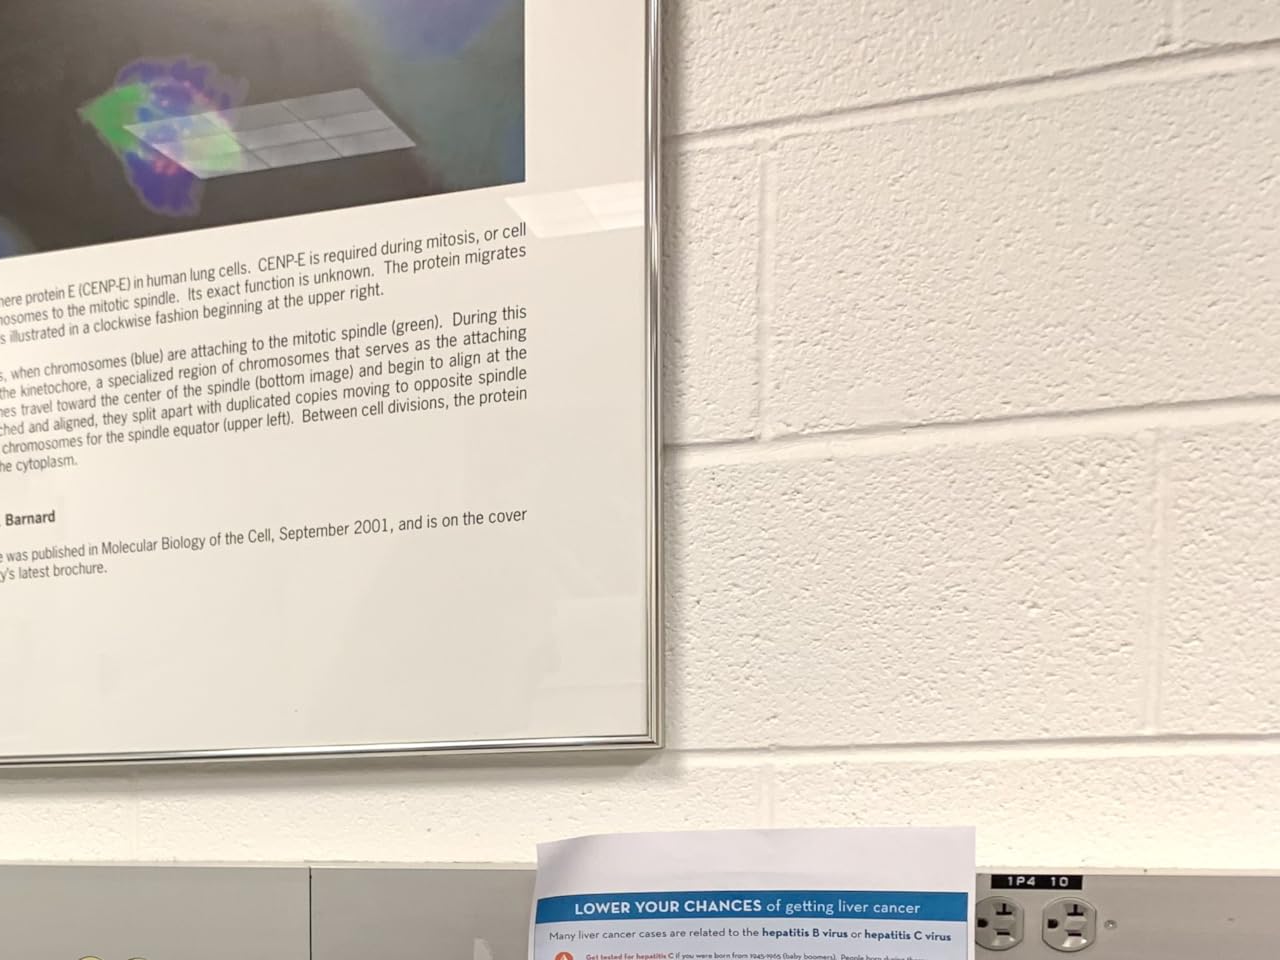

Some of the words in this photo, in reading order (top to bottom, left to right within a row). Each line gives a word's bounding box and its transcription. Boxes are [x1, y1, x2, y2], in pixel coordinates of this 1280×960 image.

[24, 287, 65, 305] protein
[67, 283, 75, 297] E
[78, 276, 130, 297] (CENP-E)
[133, 276, 143, 288] in
[146, 271, 186, 287] human
[189, 267, 215, 281] lung
[218, 260, 250, 277] cells.
[257, 251, 305, 271] CENP-E
[309, 250, 320, 265] is
[323, 241, 377, 263] required
[380, 238, 422, 255] during
[426, 229, 479, 248] mitosis,
[483, 228, 498, 241] or
[502, 221, 526, 238] cell
[133, 290, 179, 309] spindle.
[187, 287, 202, 300] Its
[206, 281, 240, 298] exact
[244, 275, 294, 293] function
[298, 272, 309, 286] is
[313, 266, 374, 284] unknown.
[383, 260, 408, 274] The
[413, 252, 459, 273] protein
[464, 245, 526, 265] migrates
[92, 314, 151, 332] clockwise
[155, 307, 198, 324] fashion
[202, 299, 262, 319] beginning
[267, 295, 279, 310] at
[283, 294, 303, 307] the
[308, 289, 345, 306] upper
[350, 282, 383, 301] right.
[130, 348, 163, 366] (blue)
[167, 349, 186, 361] are
[190, 340, 247, 358] attaching
[251, 337, 264, 351] to
[268, 335, 288, 349] the
[292, 328, 336, 346] mitotic
[341, 322, 386, 341] spindle
[391, 315, 442, 336] (green).
[452, 310, 497, 326] During
[502, 305, 526, 320] this
[178, 362, 216, 379] region
[221, 359, 233, 373] of
[238, 350, 329, 371] chromosomes
[334, 344, 359, 360] that
[365, 341, 409, 357] serves
[414, 339, 430, 351] as
[436, 334, 457, 348] the
[463, 327, 526, 345] attaching
[309, 364, 353, 383] image)
[358, 361, 382, 377] and
[387, 357, 424, 375] begin
[429, 356, 443, 369] to
[448, 352, 480, 368] align
[486, 348, 500, 363] at
[505, 346, 526, 360] the
[226, 391, 290, 412] duplicated
[295, 388, 337, 405] copies
[342, 382, 390, 399] moving
[395, 379, 408, 393] to
[414, 373, 472, 392] opposite
[478, 366, 526, 386] spindle
[302, 406, 357, 423] Between
[361, 401, 383, 416] cell
[387, 397, 448, 413] divisions,
[453, 393, 474, 407] the
[479, 387, 526, 406] protein
[4, 509, 55, 526] Barnard
[5, 550, 28, 561] was
[31, 543, 85, 561] published
[88, 543, 98, 555] in
[101, 538, 157, 554] Molecular
[161, 535, 205, 550] Biology
[209, 531, 221, 545] of
[224, 531, 244, 544] the
[247, 527, 274, 543] Cell,
[279, 522, 349, 541] September
[354, 518, 393, 534] 2001,
[398, 515, 422, 530] and
[426, 515, 437, 528] is
[441, 515, 458, 527] on
[462, 511, 483, 525] the
[488, 510, 527, 523] cover
[18, 565, 50, 579] latest
[52, 561, 107, 576] brochure.
[1007, 876, 1036, 887] 1P4
[574, 901, 630, 915] LOWER
[634, 900, 679, 914] YOUR
[683, 900, 762, 914] CHANCES
[766, 899, 780, 912] of
[785, 899, 834, 916] getting
[838, 900, 868, 913] liver
[873, 904, 920, 914] cancer
[549, 929, 575, 944] Many
[578, 929, 599, 940] liver
[602, 930, 636, 939] cancer
[638, 930, 667, 938] cases
[669, 930, 686, 938] are
[689, 926, 725, 937] related
[728, 926, 739, 937] to
[742, 926, 759, 937] the
[762, 926, 809, 941] hepatitis
[812, 927, 819, 938] B
[822, 927, 848, 938] virus
[850, 930, 861, 939] or
[864, 928, 911, 943] hepatitis
[913, 930, 922, 941] C
[924, 930, 951, 942] virus
